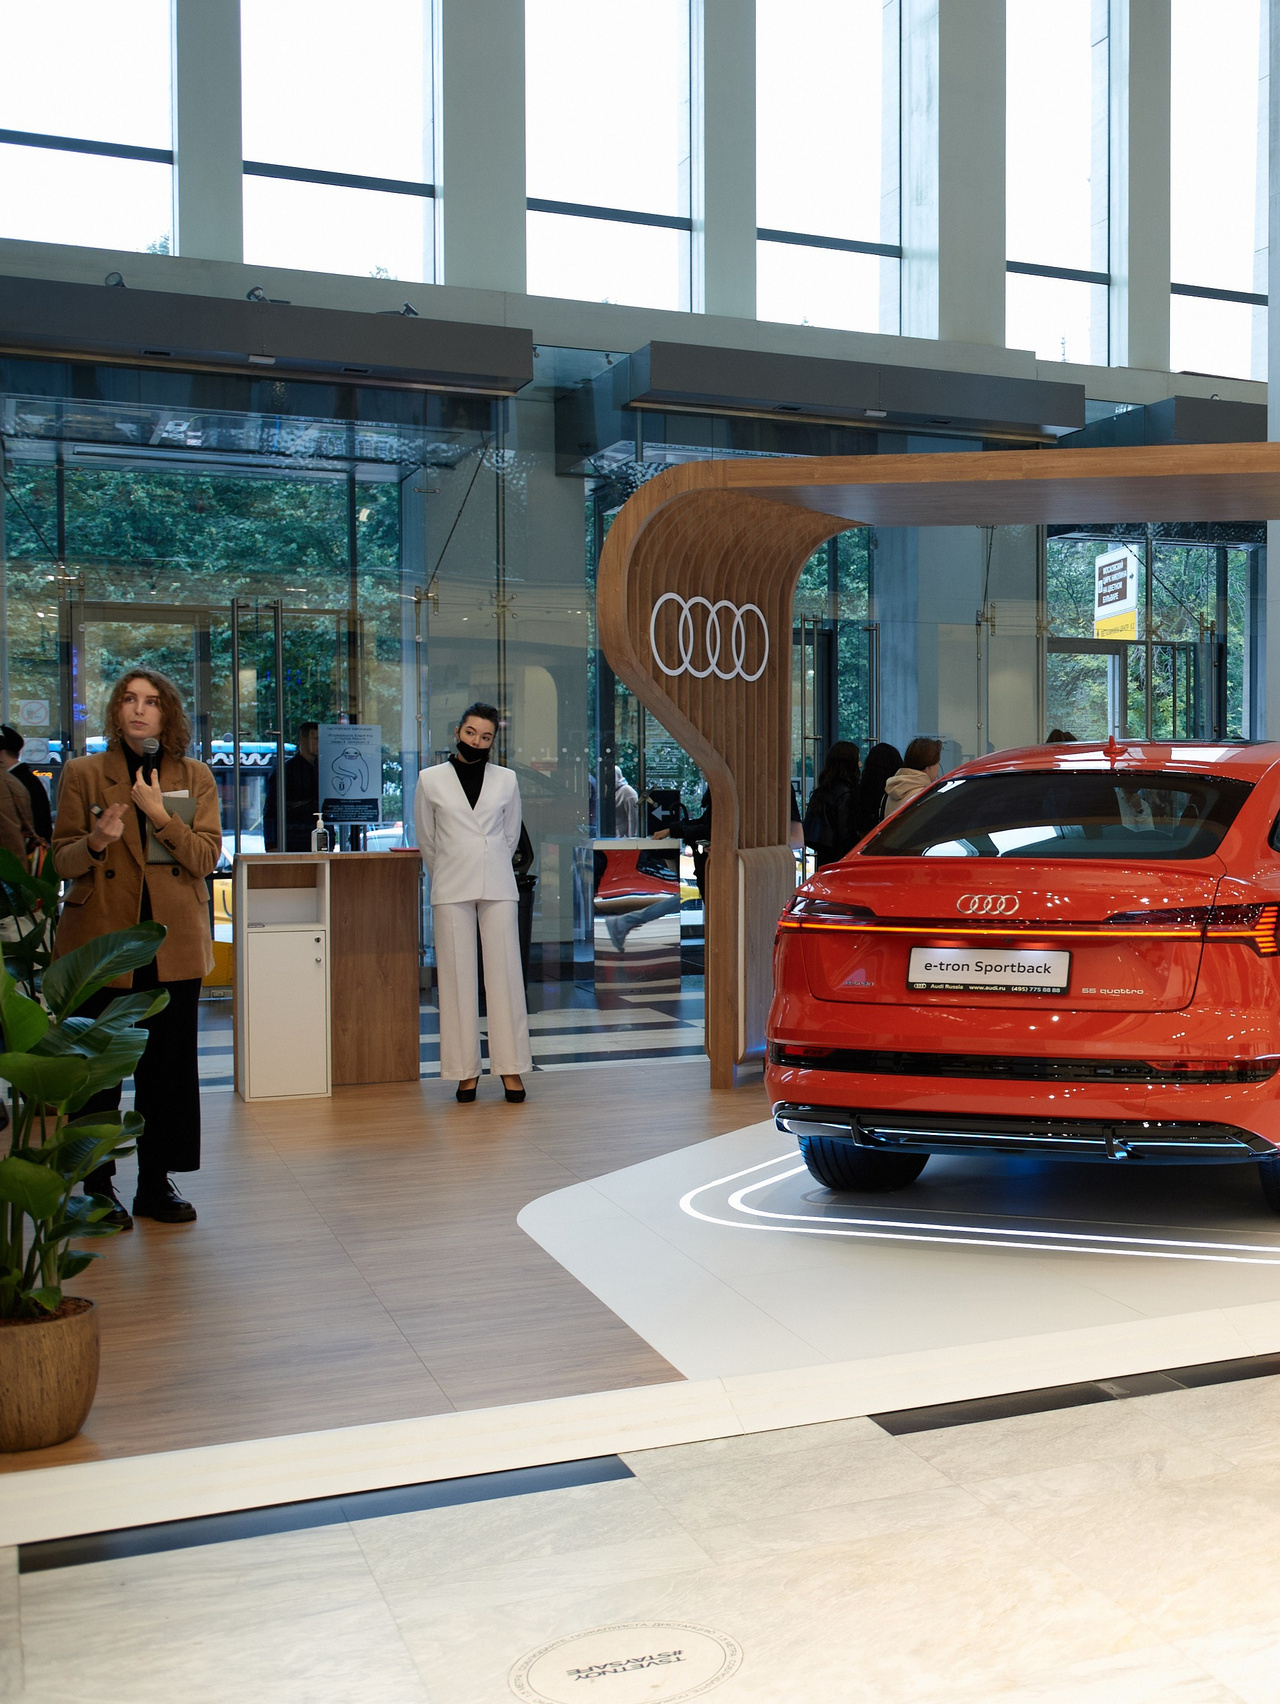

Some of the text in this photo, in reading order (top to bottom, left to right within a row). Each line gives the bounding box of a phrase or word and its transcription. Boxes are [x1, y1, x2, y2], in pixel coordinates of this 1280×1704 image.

[924, 961, 1052, 975] e-tron Sportback
[566, 1649, 683, 1677] #STAYSAFE
[574, 1656, 686, 1681] TSVETNOY
